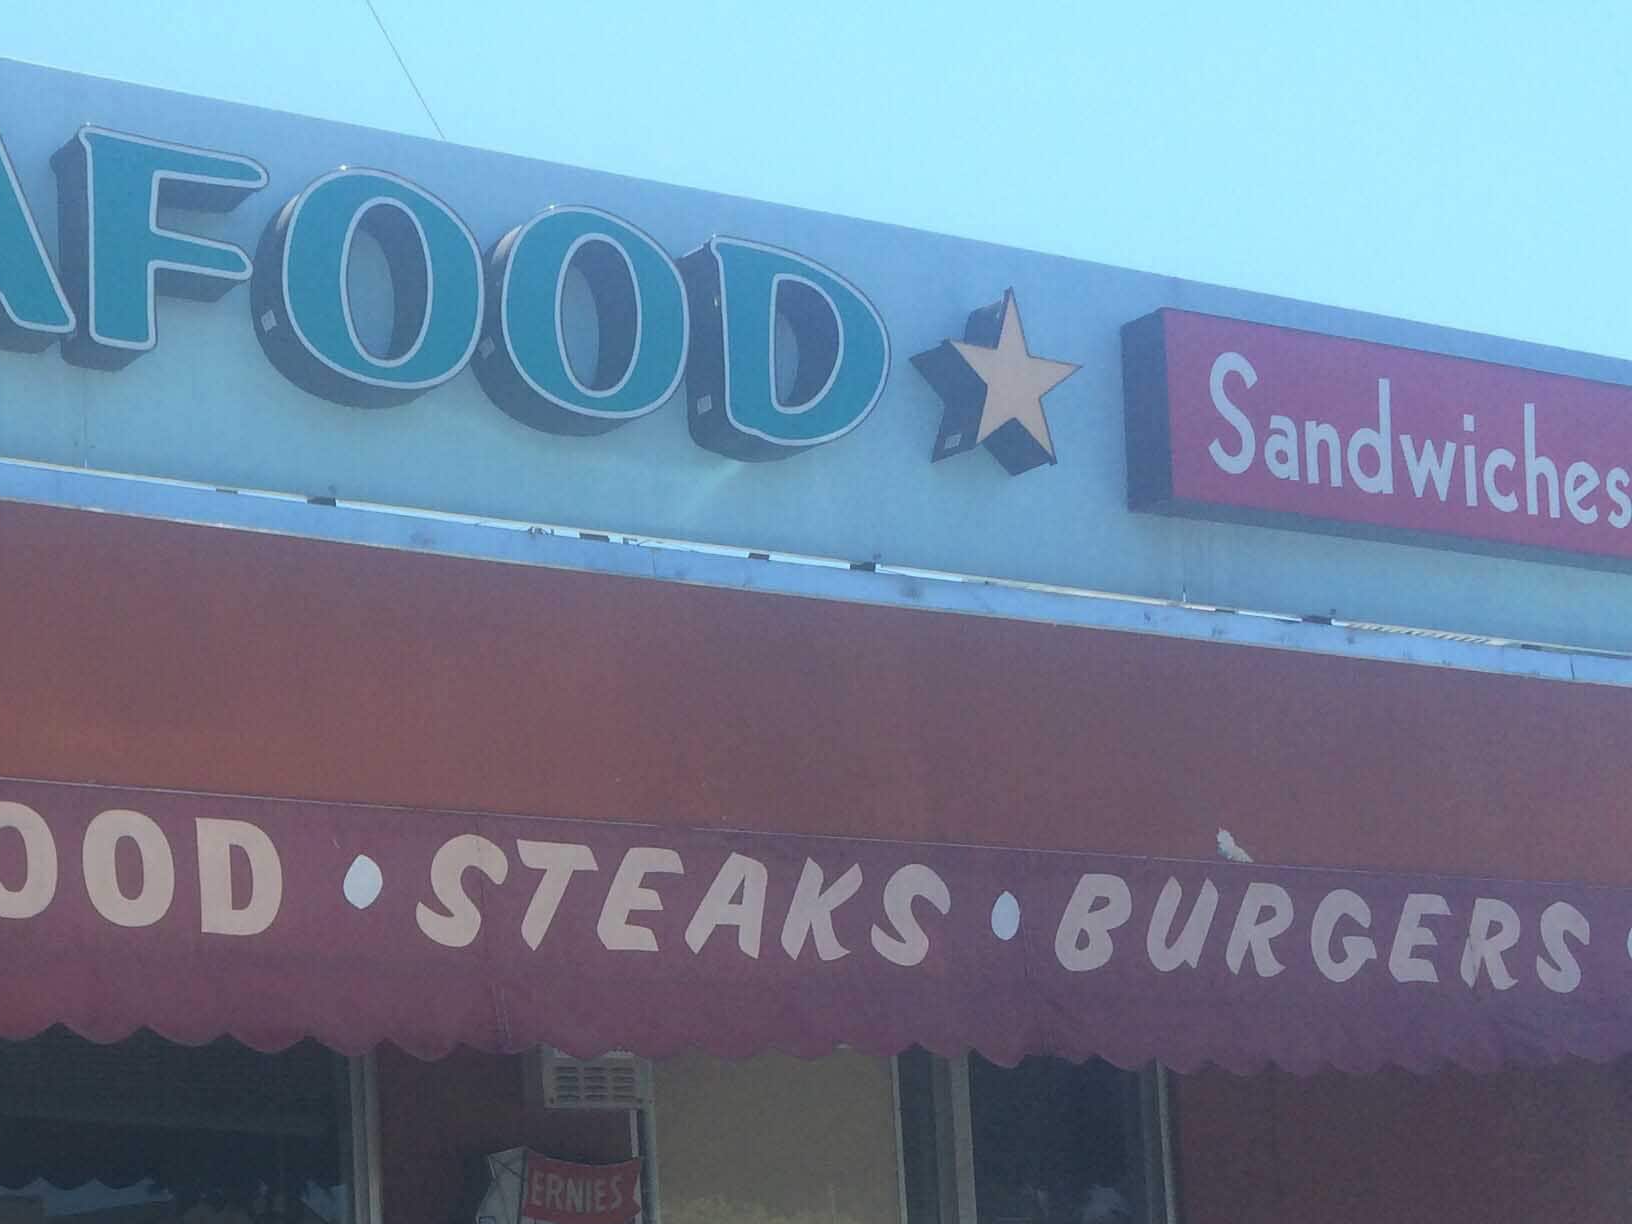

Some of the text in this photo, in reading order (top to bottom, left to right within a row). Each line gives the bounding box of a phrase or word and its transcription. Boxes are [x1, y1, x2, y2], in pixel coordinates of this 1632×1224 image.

[1208, 351, 1632, 528] Sandwiches
[415, 834, 951, 966] STEAKS
[1054, 873, 1590, 993] BURGERS
